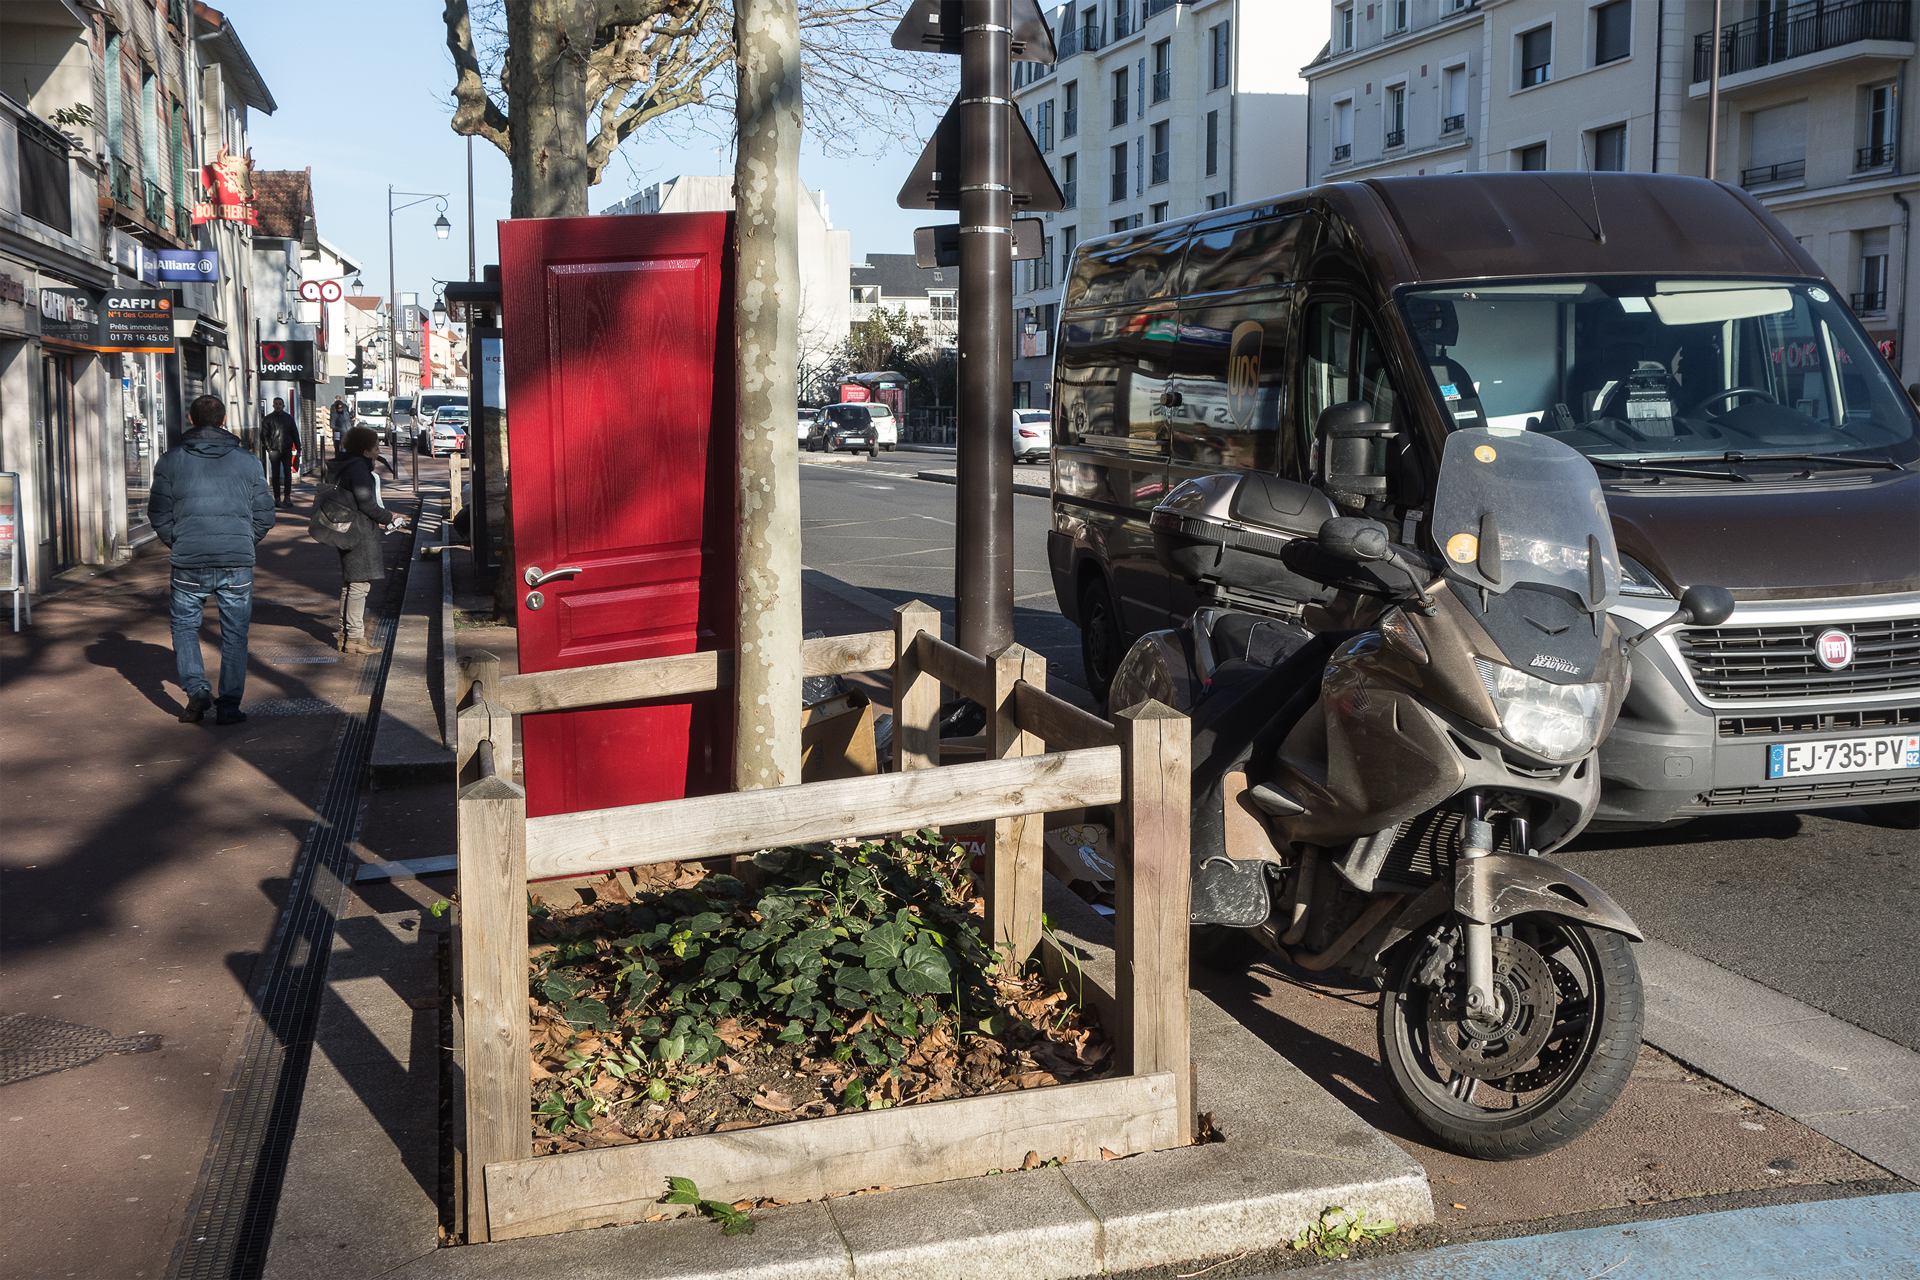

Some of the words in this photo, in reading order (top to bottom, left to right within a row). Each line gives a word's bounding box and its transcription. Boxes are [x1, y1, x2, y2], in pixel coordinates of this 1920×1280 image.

[197, 204, 253, 220] BOUCHERIE
[158, 260, 196, 270] Allianz
[108, 298, 156, 309] CAFPI
[159, 334, 169, 342] 05
[268, 361, 304, 373] optique
[1825, 641, 1846, 659] FIAT
[1536, 653, 1573, 666] HONDA
[1529, 659, 1580, 675] DEAUVILLE
[1787, 739, 1903, 772] EJ-735-PV
[1907, 752, 1919, 765] 92
[1774, 764, 1780, 772] F
